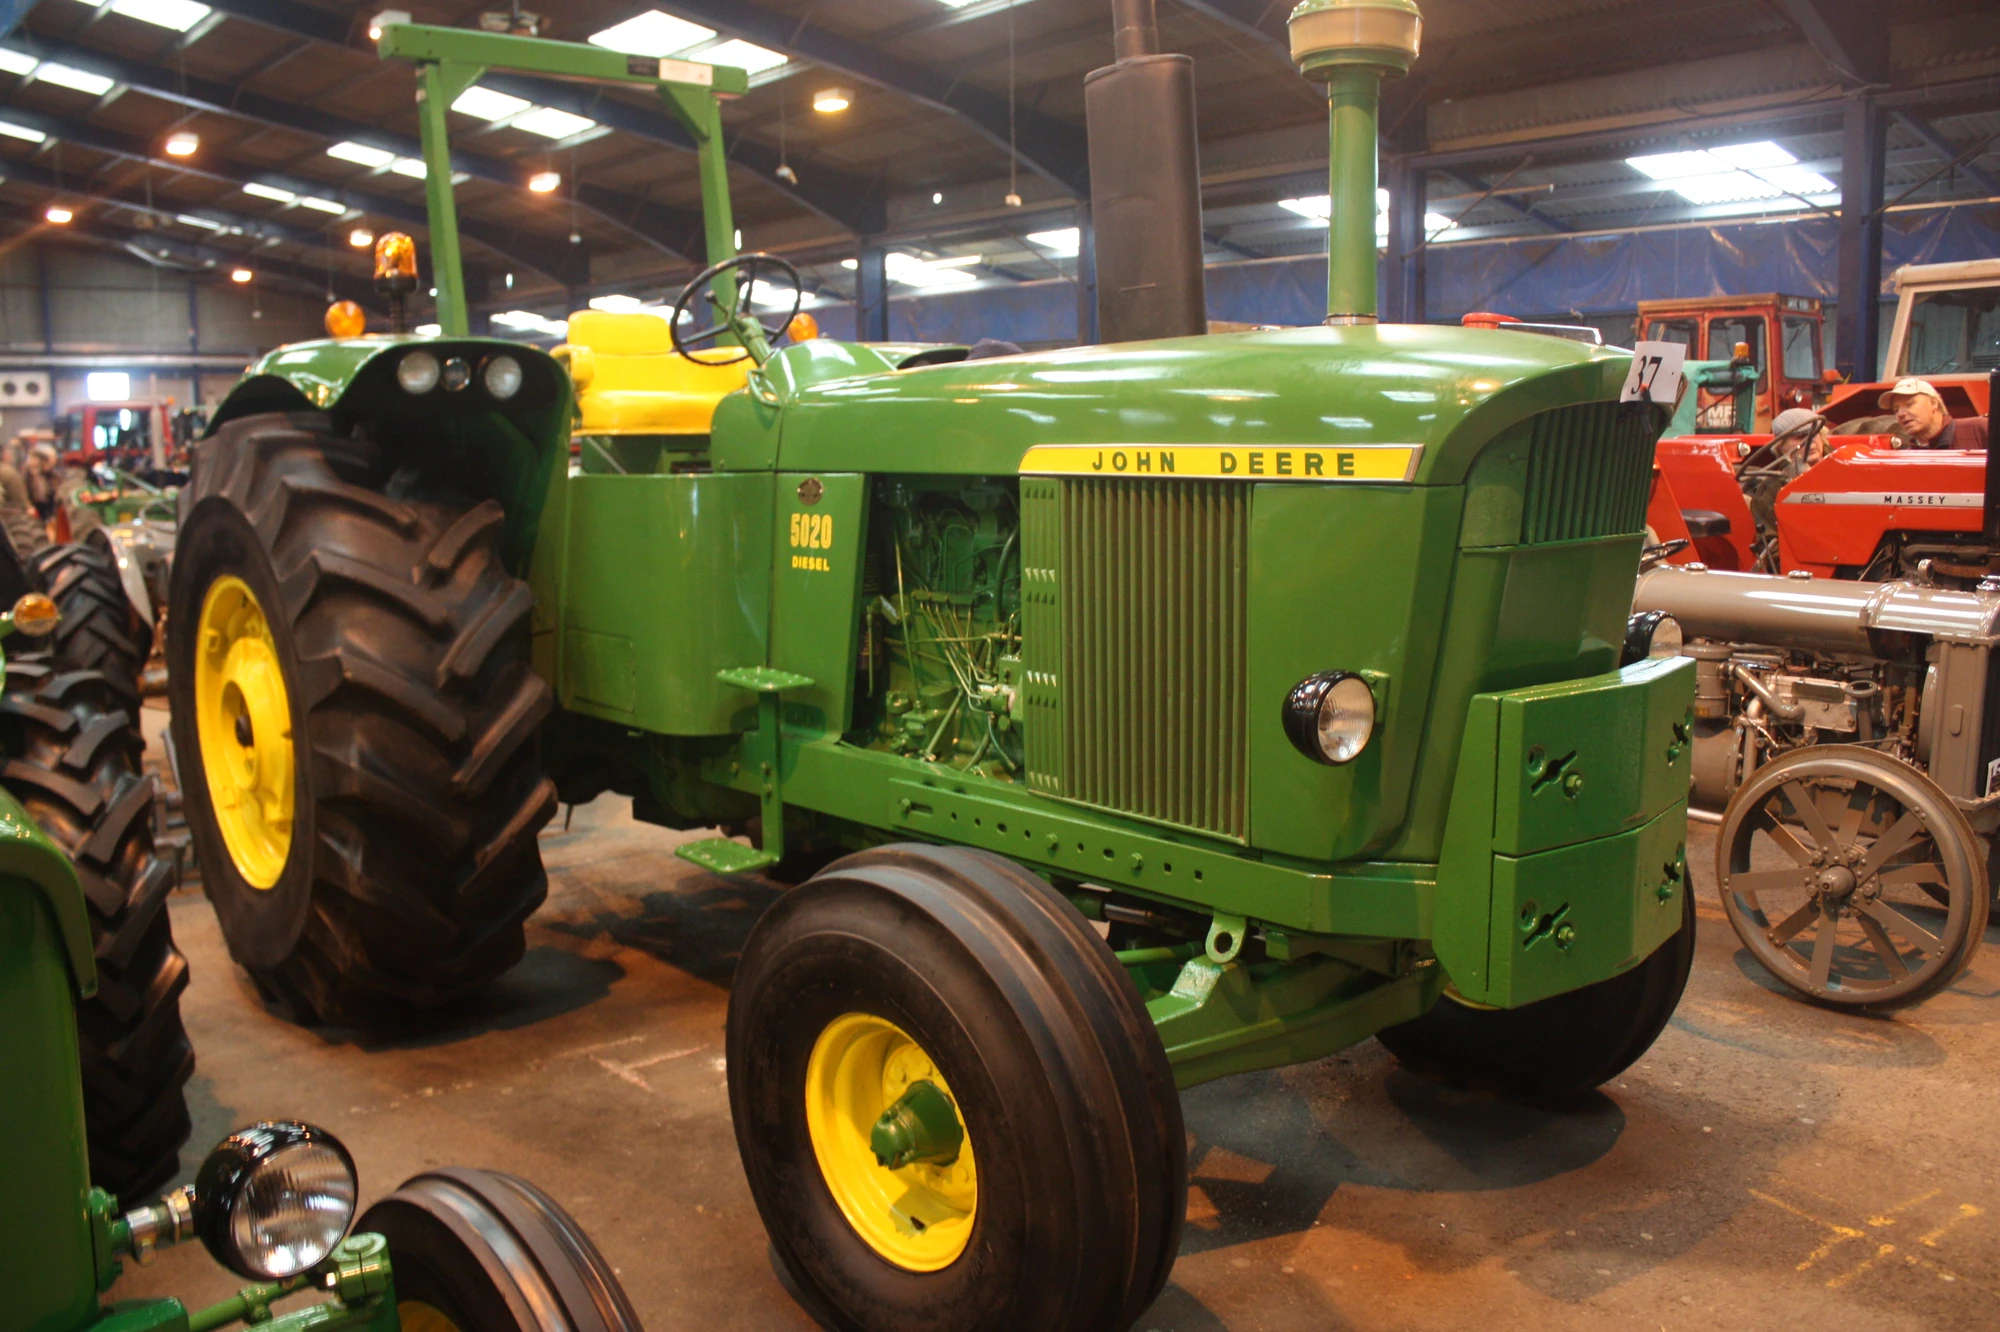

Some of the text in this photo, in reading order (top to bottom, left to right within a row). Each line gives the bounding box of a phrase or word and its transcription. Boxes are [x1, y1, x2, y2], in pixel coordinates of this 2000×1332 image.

[1631, 355, 1663, 395] 37
[1092, 451, 1355, 476] JOHN DEERE
[1884, 495, 1946, 505] MASSEY
[790, 513, 832, 549] 5020
[792, 555, 830, 572] DIESEL
